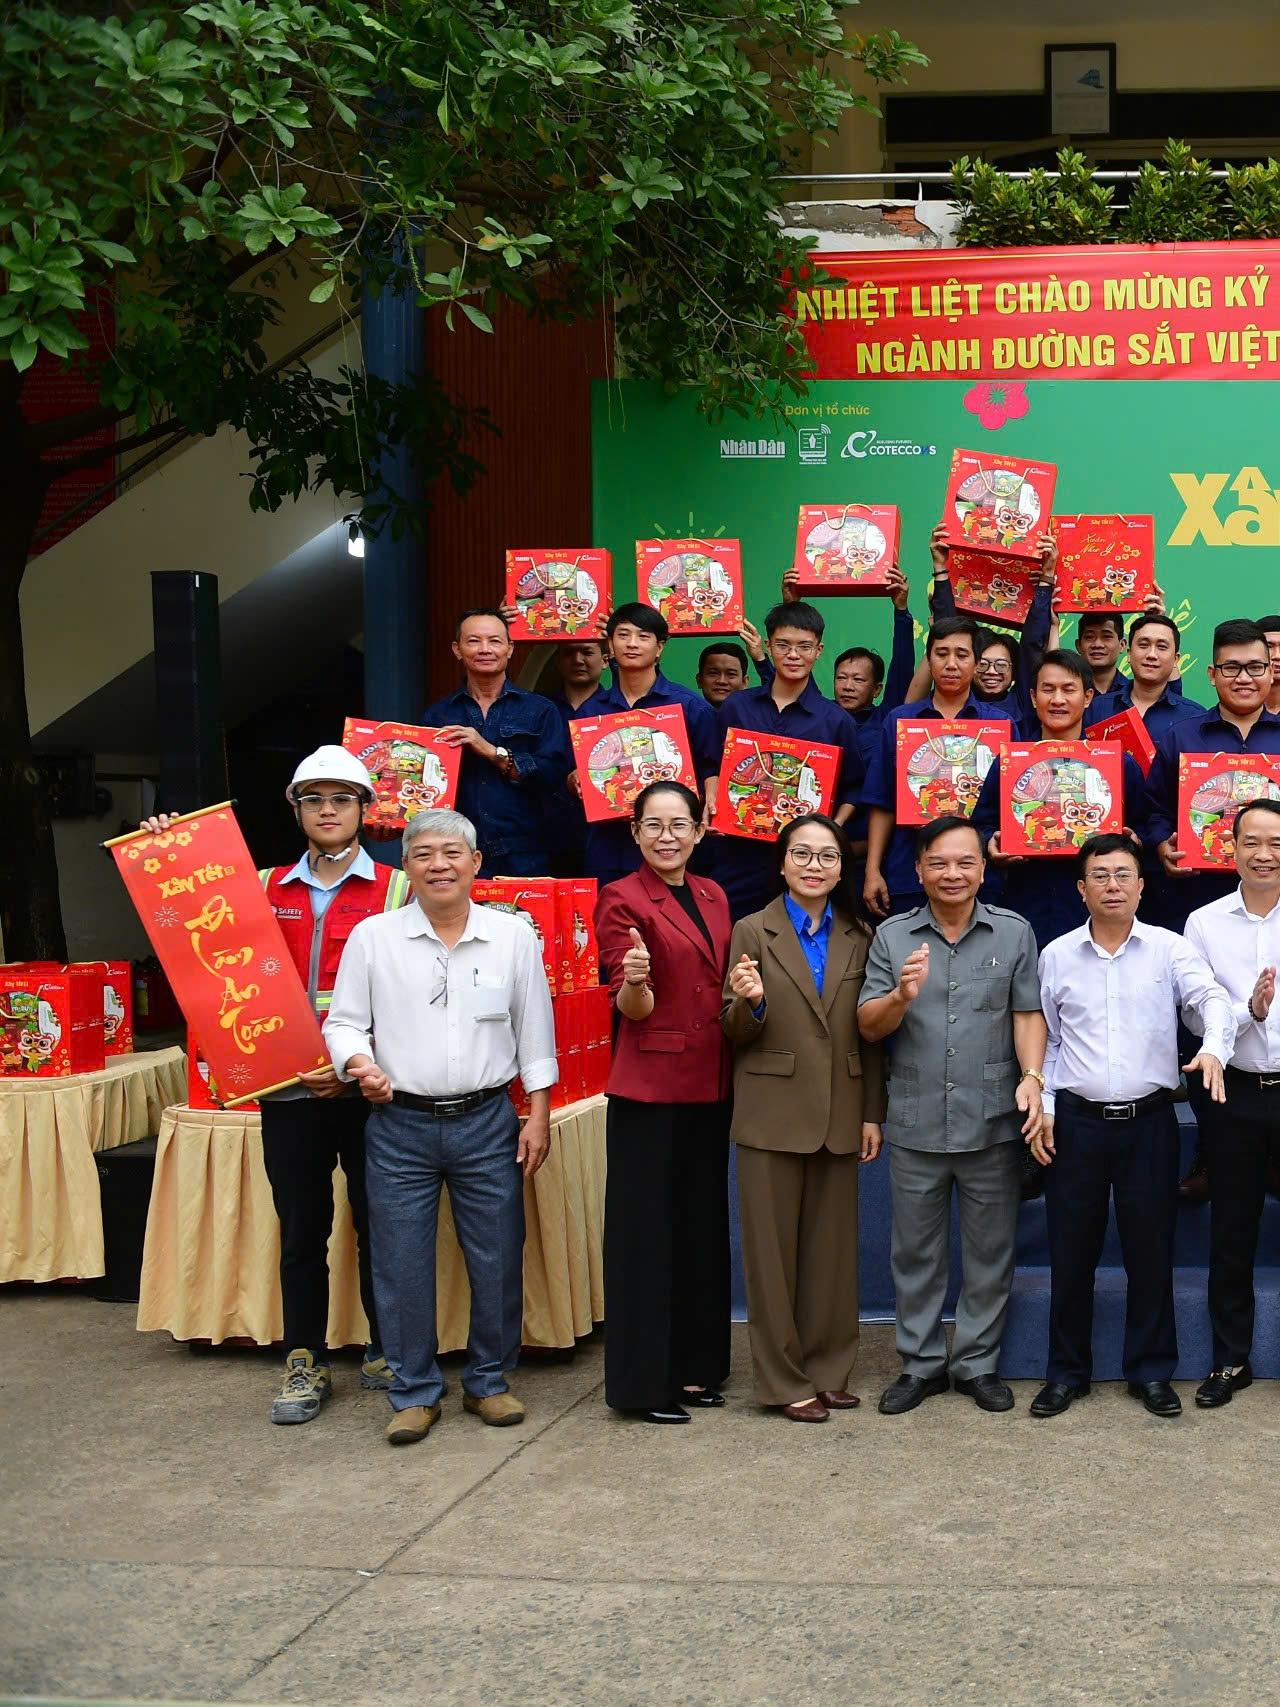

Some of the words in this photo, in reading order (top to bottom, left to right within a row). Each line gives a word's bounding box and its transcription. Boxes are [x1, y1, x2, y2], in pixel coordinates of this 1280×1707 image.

[797, 282, 899, 326] NHIỆT
[912, 279, 982, 322] LIỆT
[995, 275, 1091, 314] CHÀO
[1103, 272, 1212, 310] MỪNG
[1224, 264, 1269, 307] KỶ
[857, 335, 980, 374] NGÀNH
[991, 328, 1115, 369] ĐƯỜNG
[1128, 321, 1195, 365] SẮT
[1207, 324, 1280, 369] VIỆT
[785, 405, 809, 416] Đơn
[812, 405, 823, 417] vị
[826, 402, 839, 415] tổ
[841, 404, 870, 416] chức
[720, 439, 758, 456] Nhân
[758, 439, 785, 456] Dân
[157, 876, 196, 899] Xây
[193, 862, 224, 886] Tết
